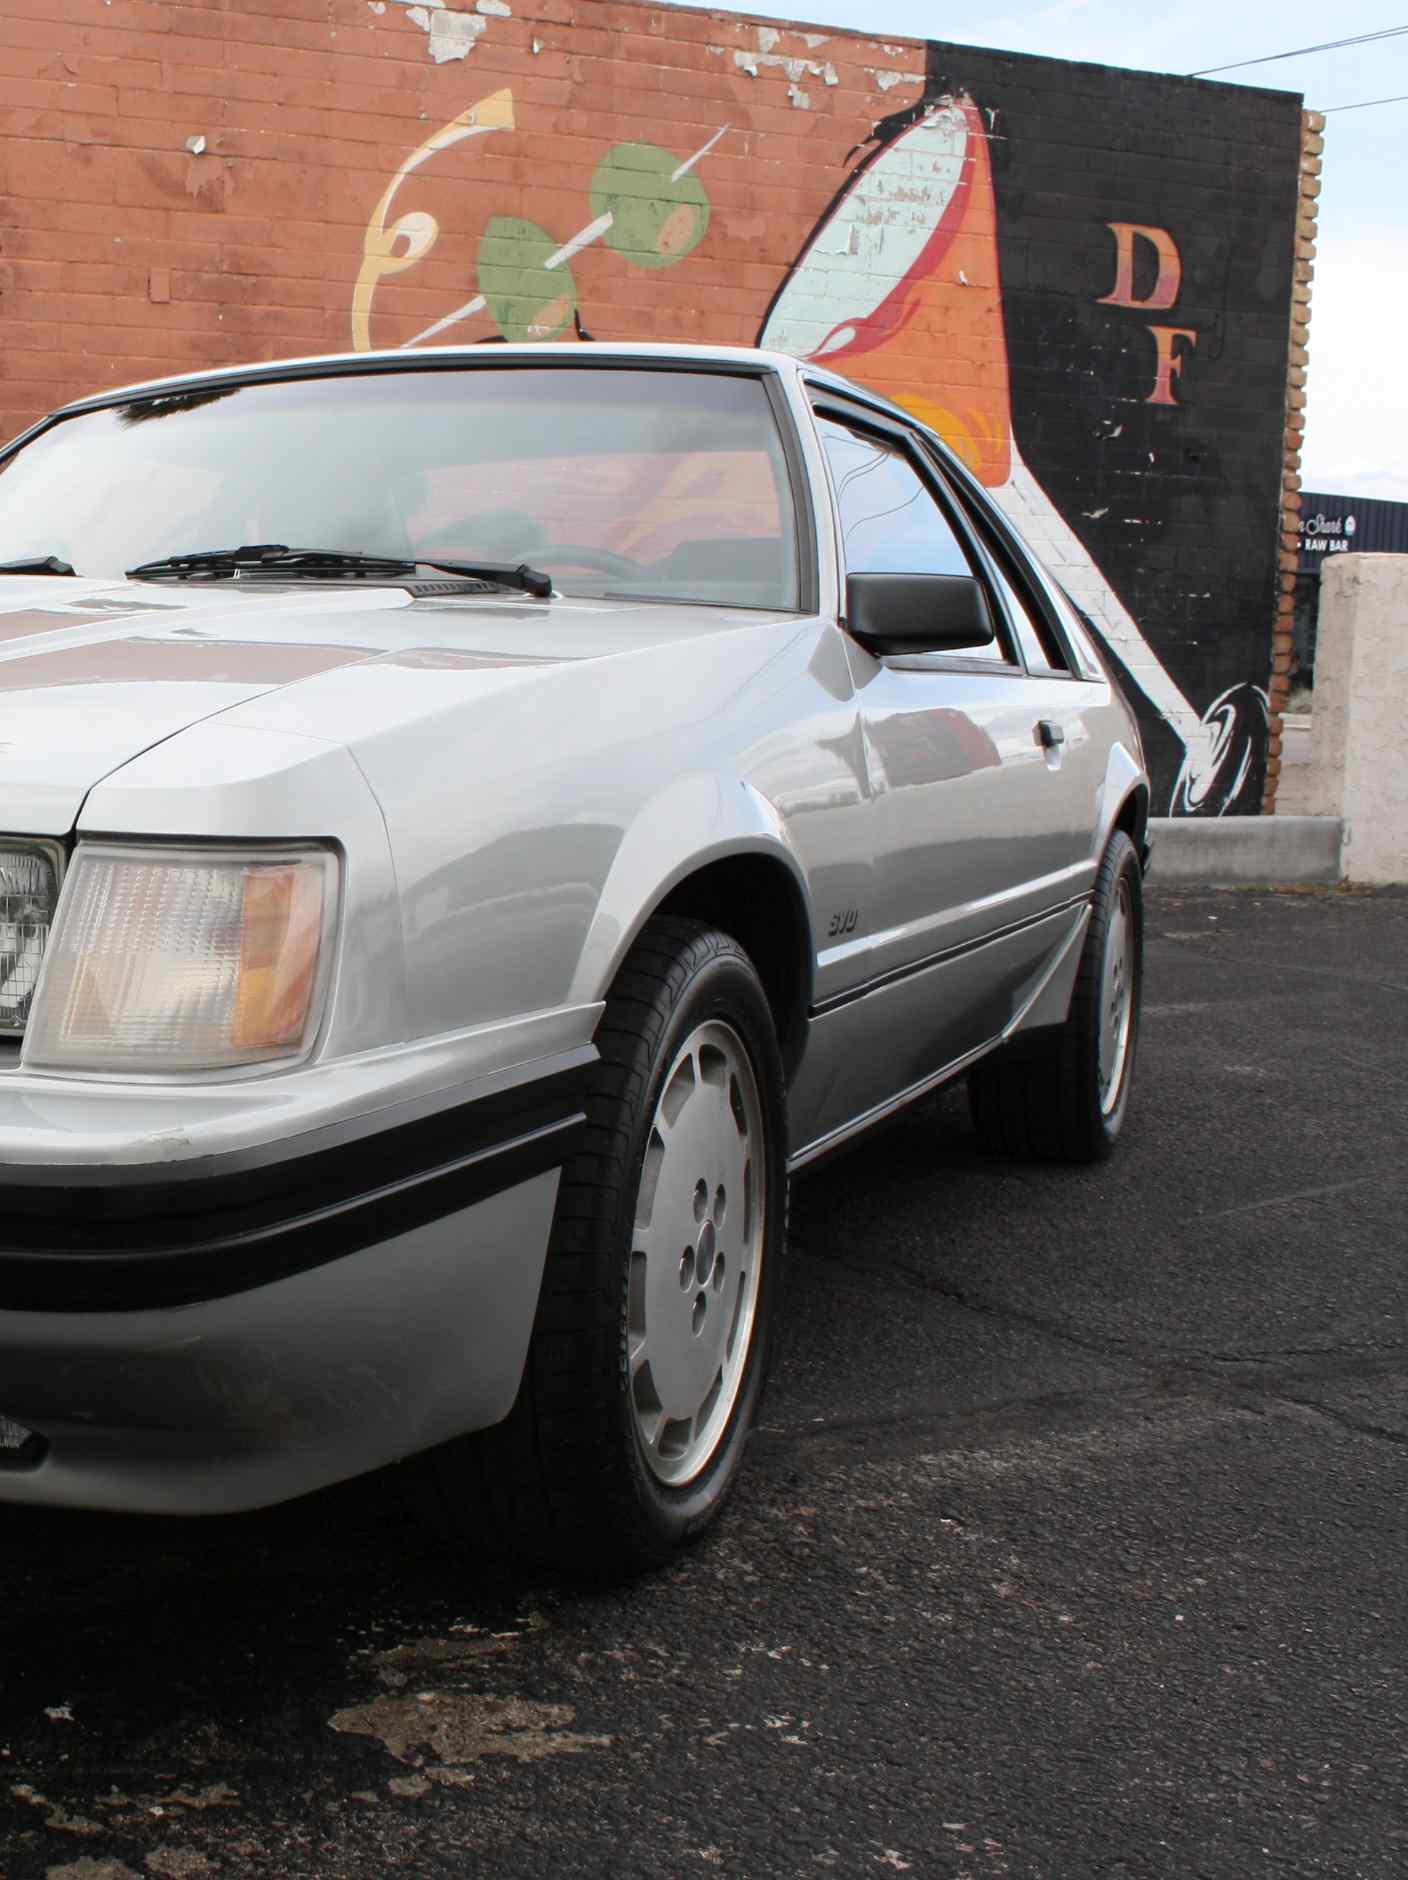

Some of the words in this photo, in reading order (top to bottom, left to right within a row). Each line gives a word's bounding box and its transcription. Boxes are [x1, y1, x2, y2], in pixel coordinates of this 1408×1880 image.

[1095, 222, 1182, 310] D
[1144, 325, 1197, 406] F
[1304, 539, 1328, 552] RAW
[1329, 539, 1349, 552] BAR
